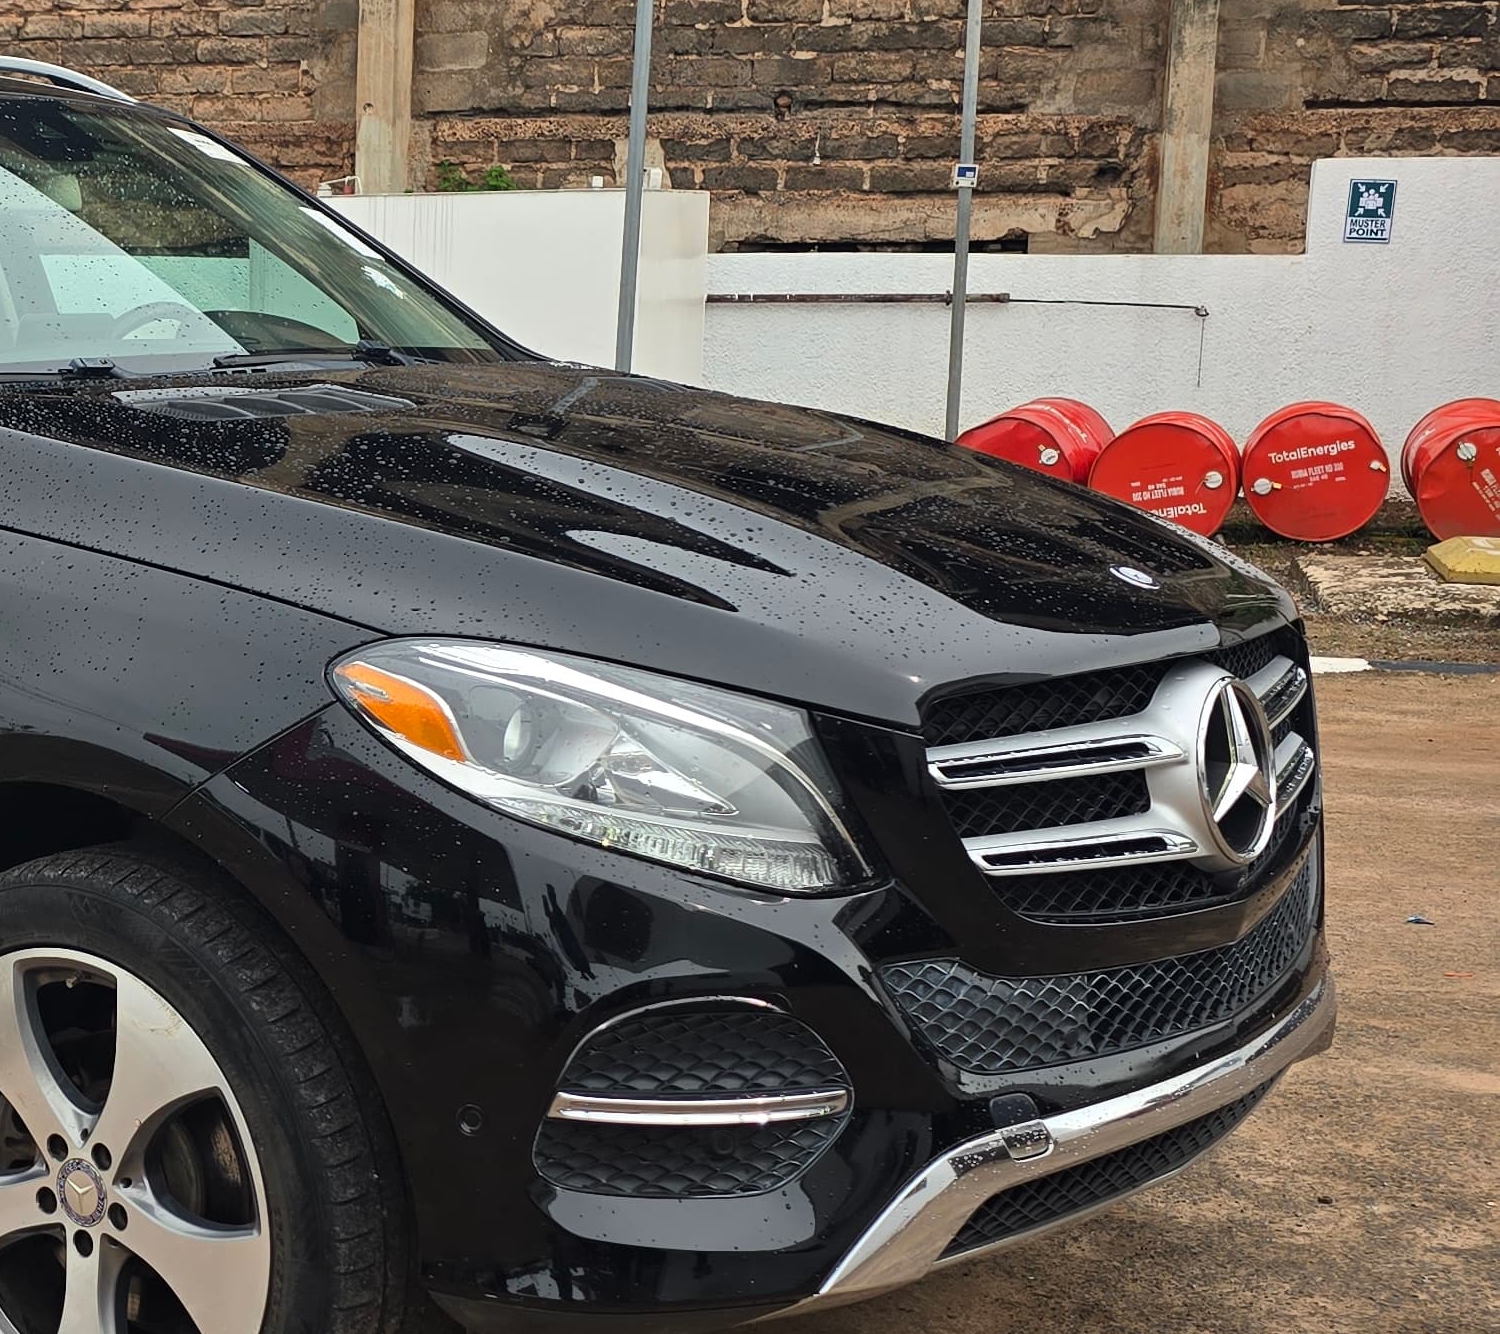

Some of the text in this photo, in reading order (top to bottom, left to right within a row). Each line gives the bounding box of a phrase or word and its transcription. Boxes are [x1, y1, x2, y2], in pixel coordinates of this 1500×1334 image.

[1350, 219, 1386, 228] MUSTER
[1349, 228, 1386, 236] POINT
[1268, 440, 1355, 464] TotalEnergies
